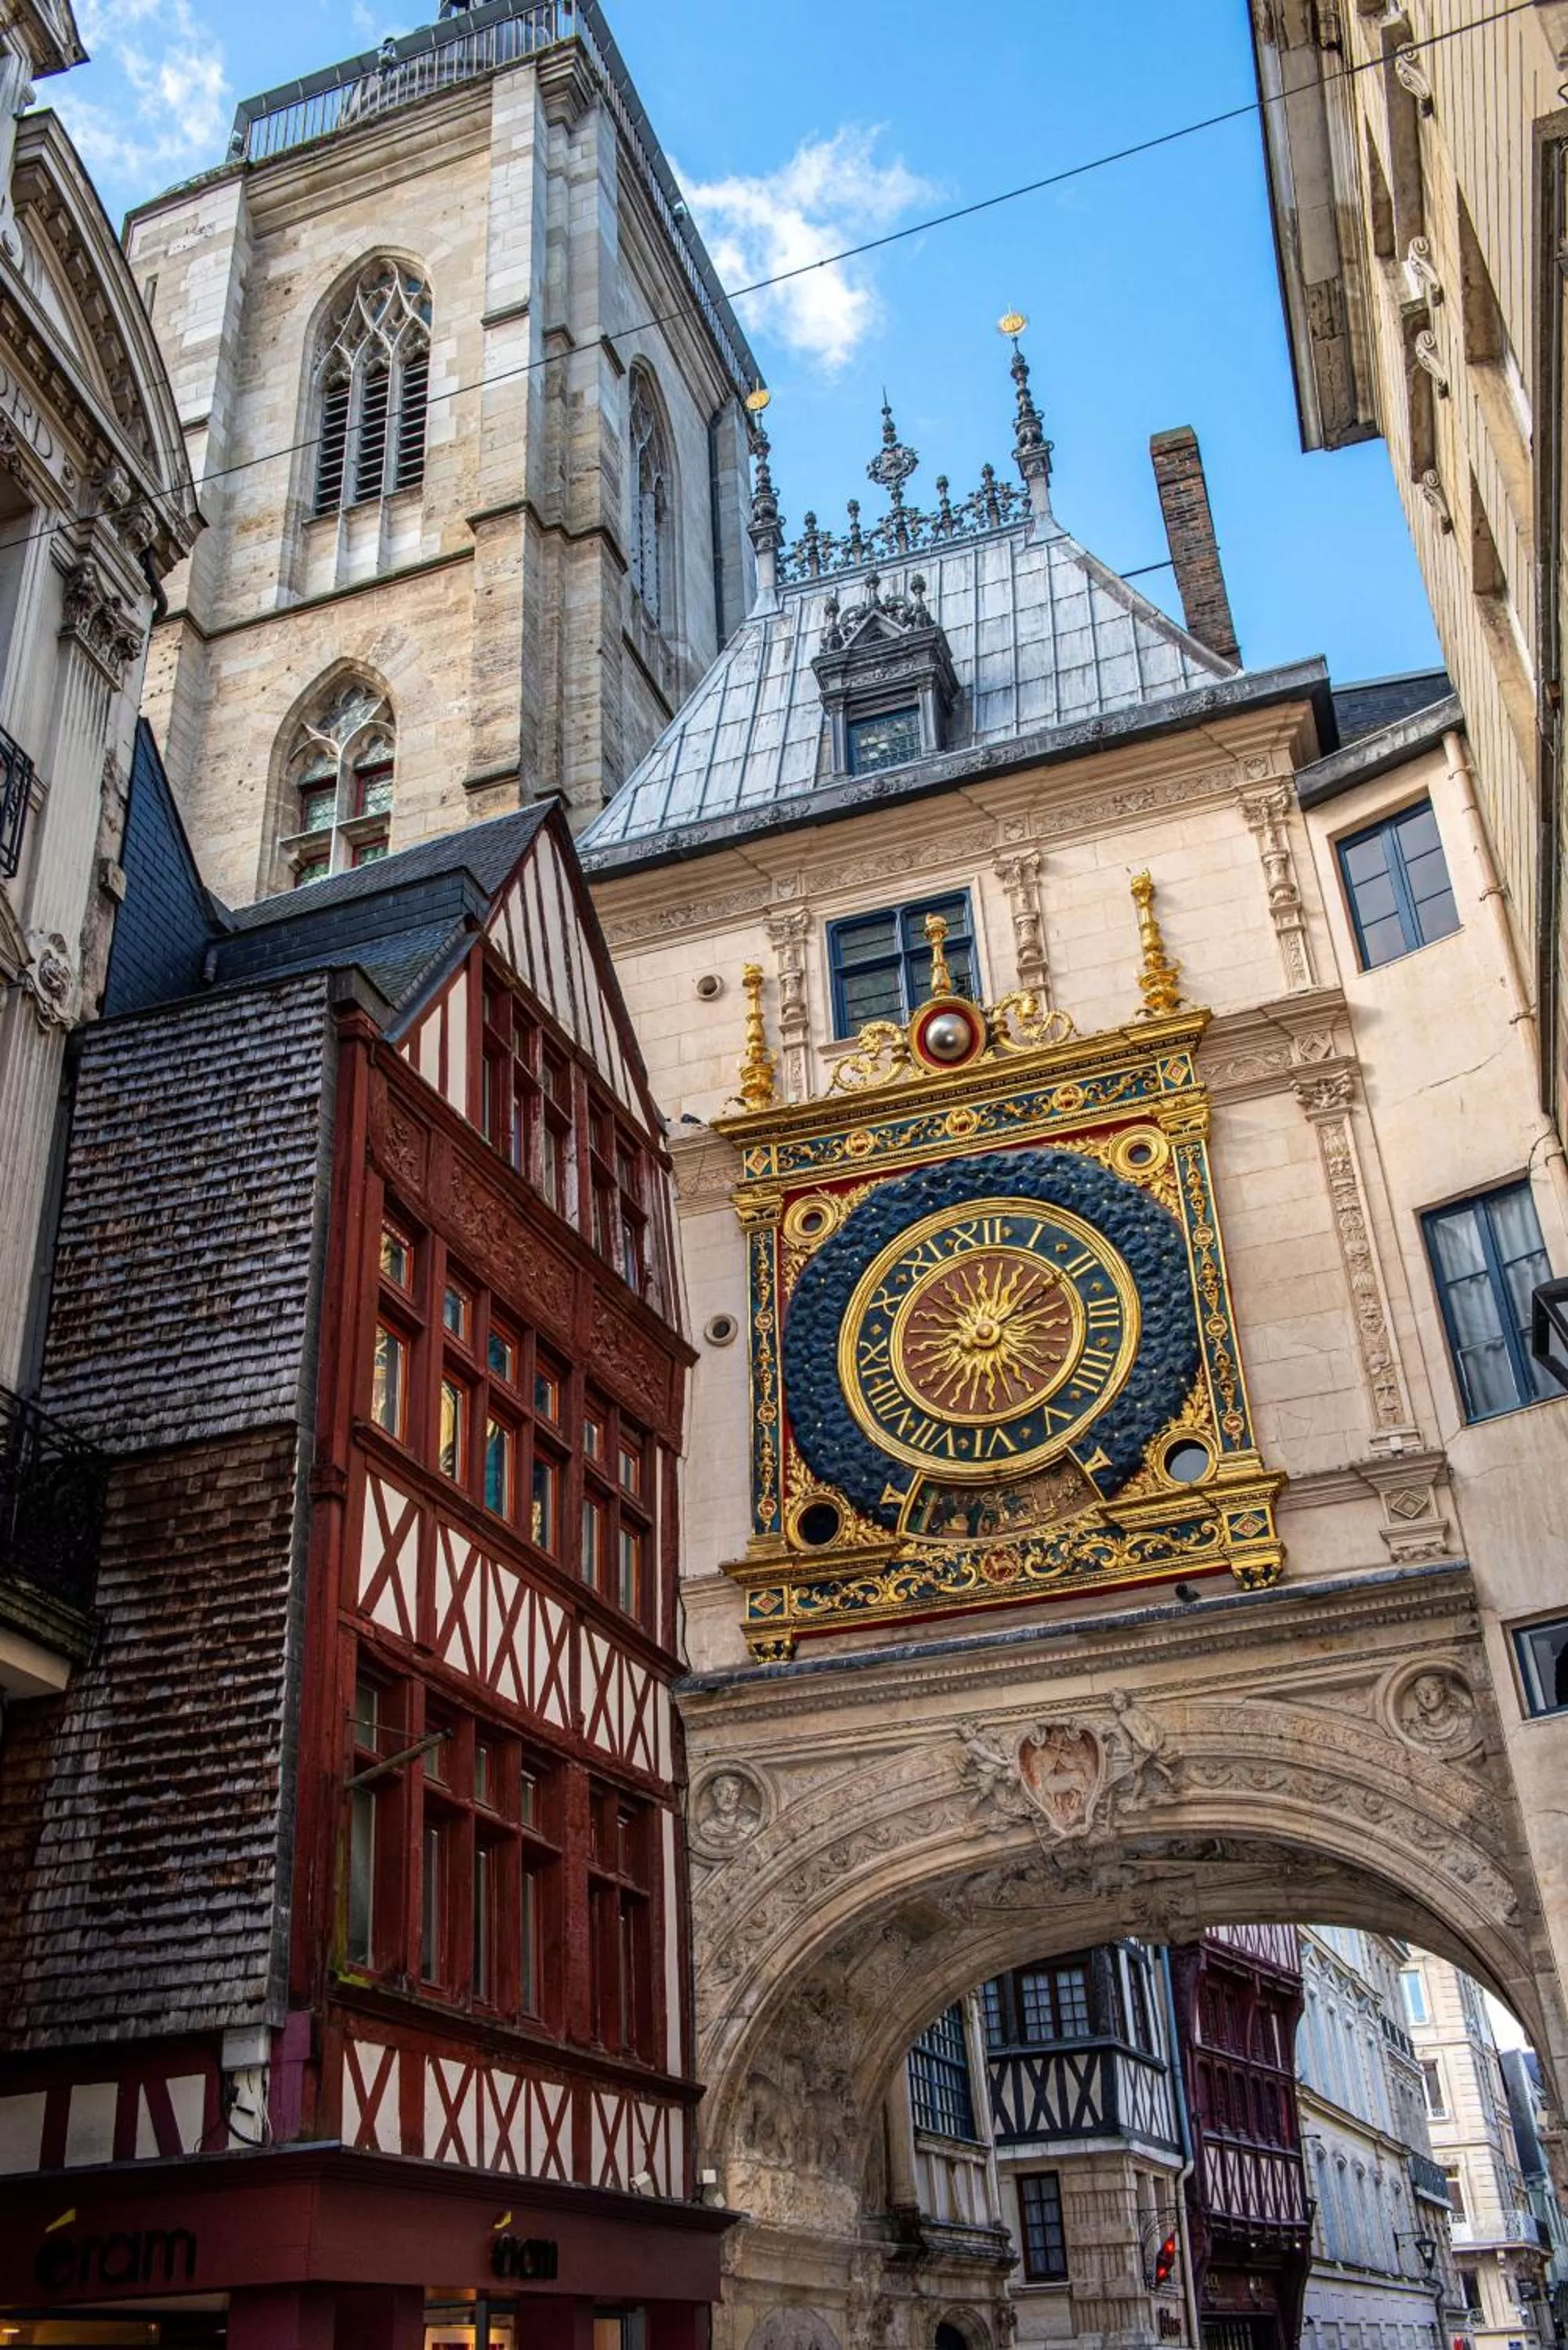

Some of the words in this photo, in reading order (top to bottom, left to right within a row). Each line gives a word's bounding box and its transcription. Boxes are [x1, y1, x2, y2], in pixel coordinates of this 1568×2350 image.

[950, 1218, 1002, 1255] XII
[1027, 1224, 1045, 1249] I
[898, 1240, 945, 1283] XI
[1064, 1250, 1099, 1279] II
[869, 1286, 905, 1319] X
[1087, 1295, 1120, 1329] III
[858, 1338, 891, 1379] IX
[1071, 1347, 1115, 1394] IIII
[867, 1379, 913, 1437] VIII
[1044, 1406, 1075, 1436] V
[909, 1418, 957, 1457] VII
[973, 1427, 1019, 1458] VI
